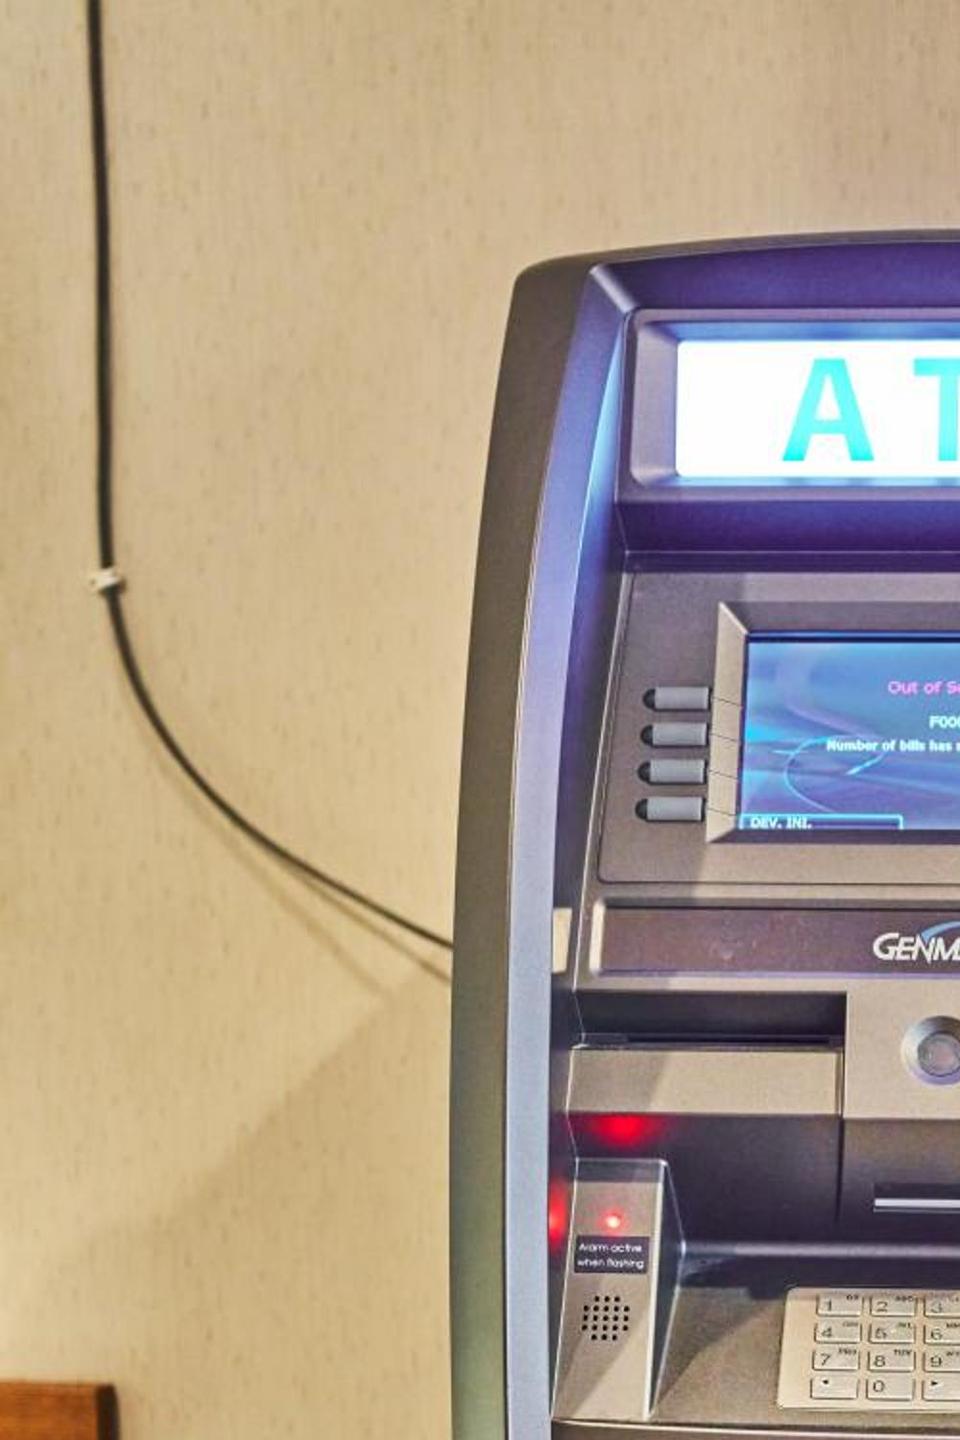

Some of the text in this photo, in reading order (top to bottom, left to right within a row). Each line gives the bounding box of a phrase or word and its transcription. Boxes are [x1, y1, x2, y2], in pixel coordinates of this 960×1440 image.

[888, 681, 918, 694] Out
[924, 681, 943, 695] of
[826, 739, 878, 752] Number
[882, 739, 897, 752] of
[900, 739, 926, 752] bills
[929, 739, 952, 752] has
[750, 817, 782, 829] DEV.
[579, 1243, 642, 1253] Alarm active
[577, 1258, 644, 1270] when flashing
[876, 1301, 888, 1312] 2
[821, 1327, 832, 1338] 4
[875, 1328, 887, 1339] 5
[930, 1328, 942, 1340] 6
[821, 1353, 831, 1366] 7
[874, 1355, 886, 1367] 8
[930, 1355, 942, 1368] 9
[873, 1380, 885, 1392] 0
